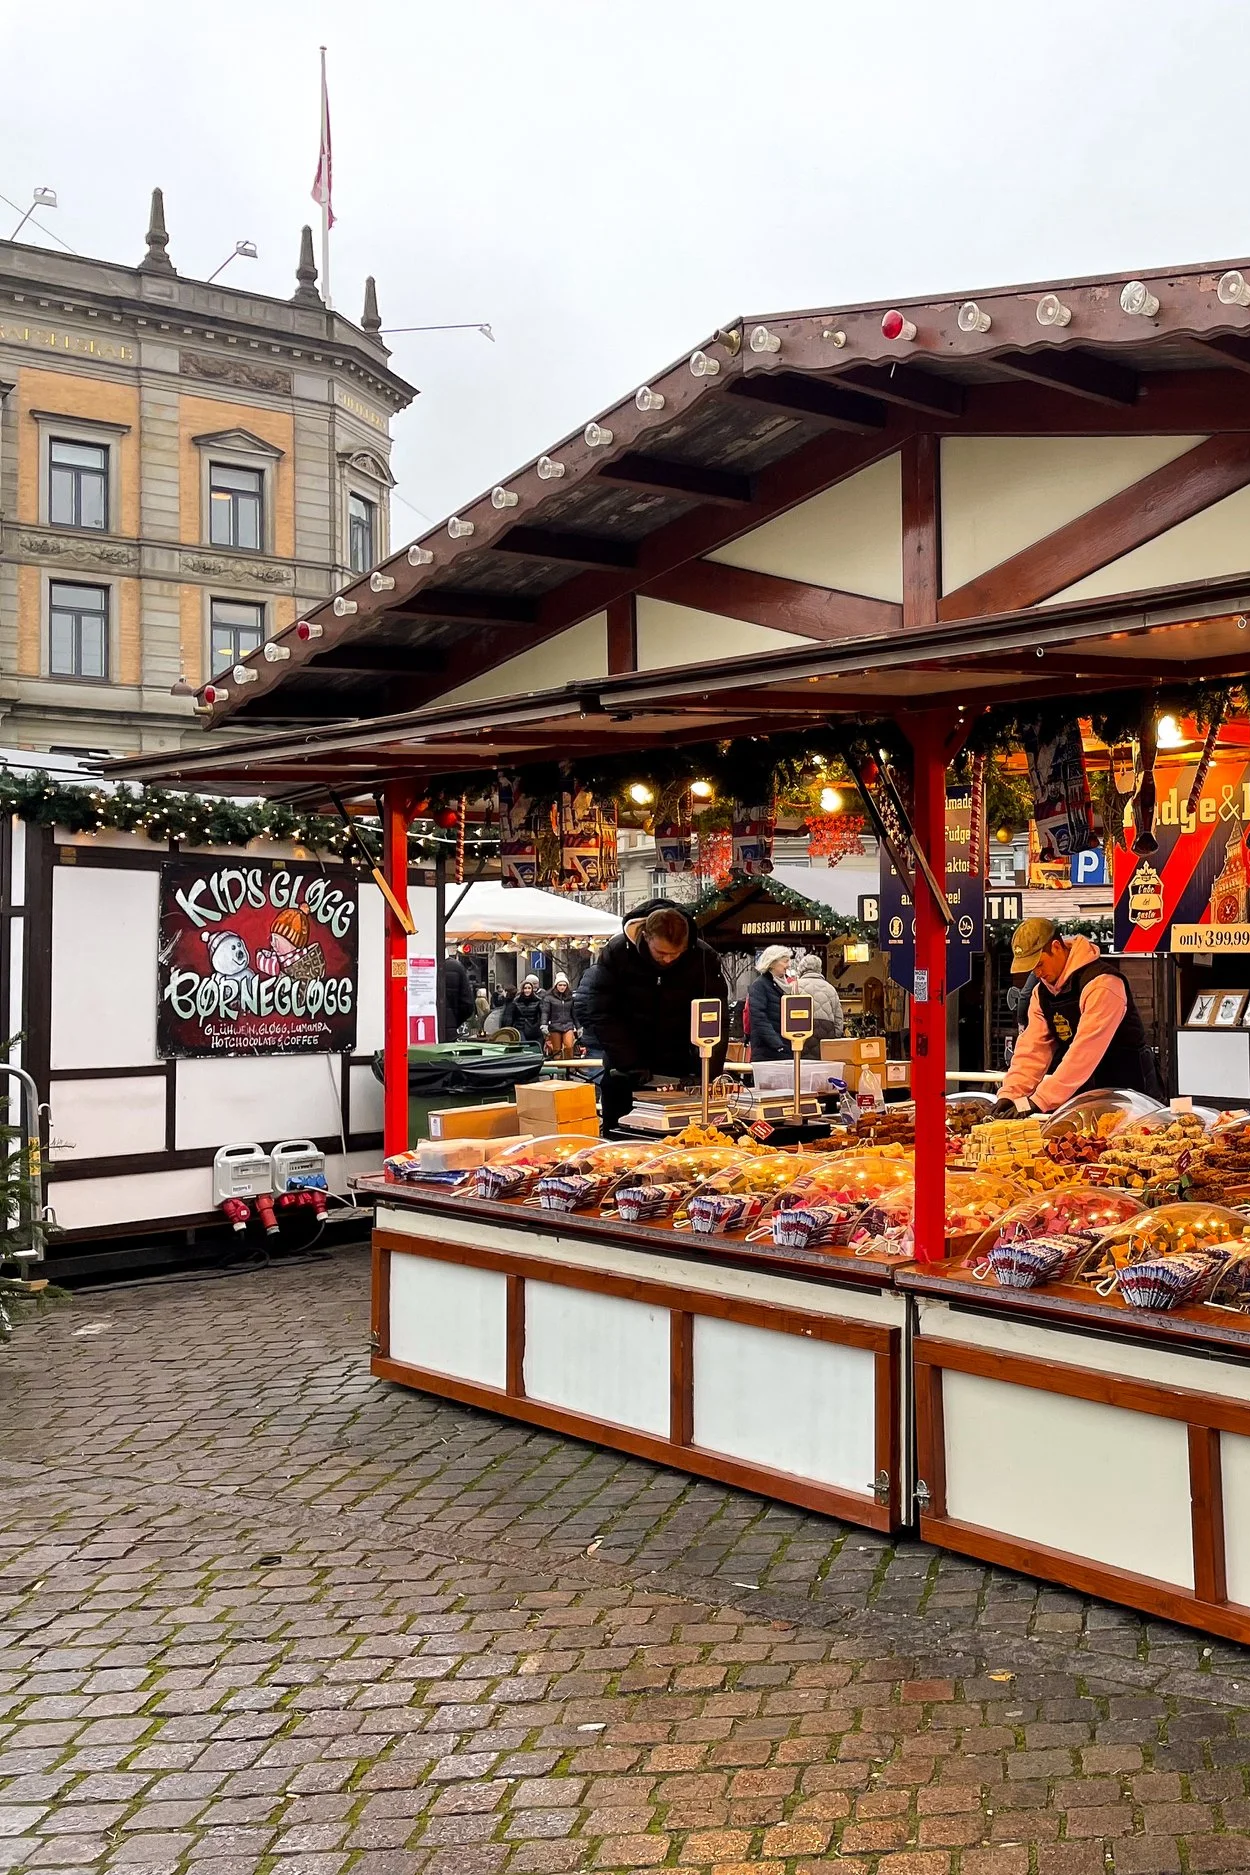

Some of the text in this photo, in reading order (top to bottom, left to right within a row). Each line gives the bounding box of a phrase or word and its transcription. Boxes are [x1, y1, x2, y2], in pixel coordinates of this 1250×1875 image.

[1078, 850, 1098, 883] P
[175, 868, 355, 938] KID'S GLØGG
[1136, 910, 1156, 921] gusto
[741, 921, 785, 935] HORSESHOE
[789, 919, 811, 932] WITH
[1179, 931, 1204, 949] only
[164, 966, 353, 1027] BØRNEGLØGG
